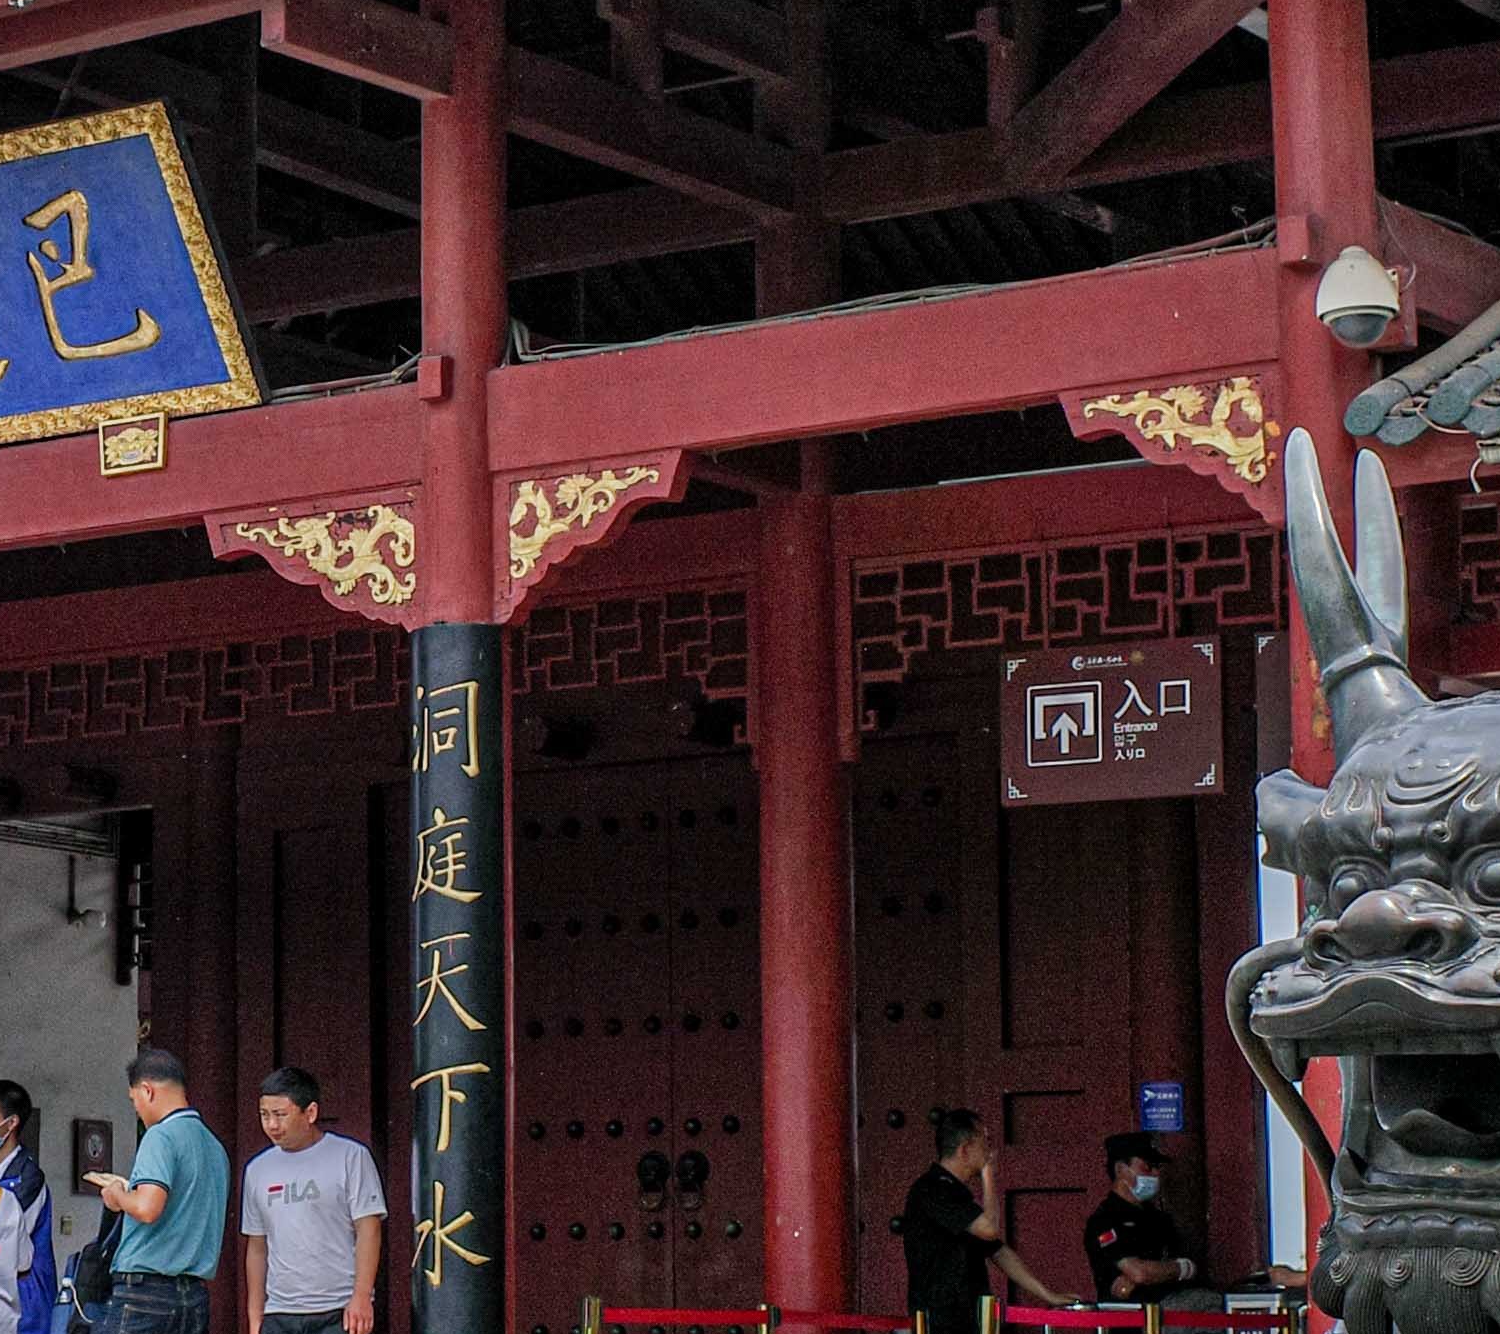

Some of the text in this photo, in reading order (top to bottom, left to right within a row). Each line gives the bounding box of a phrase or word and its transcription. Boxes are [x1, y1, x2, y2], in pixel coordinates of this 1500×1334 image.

[1114, 679, 1191, 719] 入口
[1113, 721, 1158, 734] Entrance
[1114, 748, 1145, 761] 入り口
[411, 676, 491, 1287] 洞庭天下水
[267, 1179, 320, 1207] FILA
